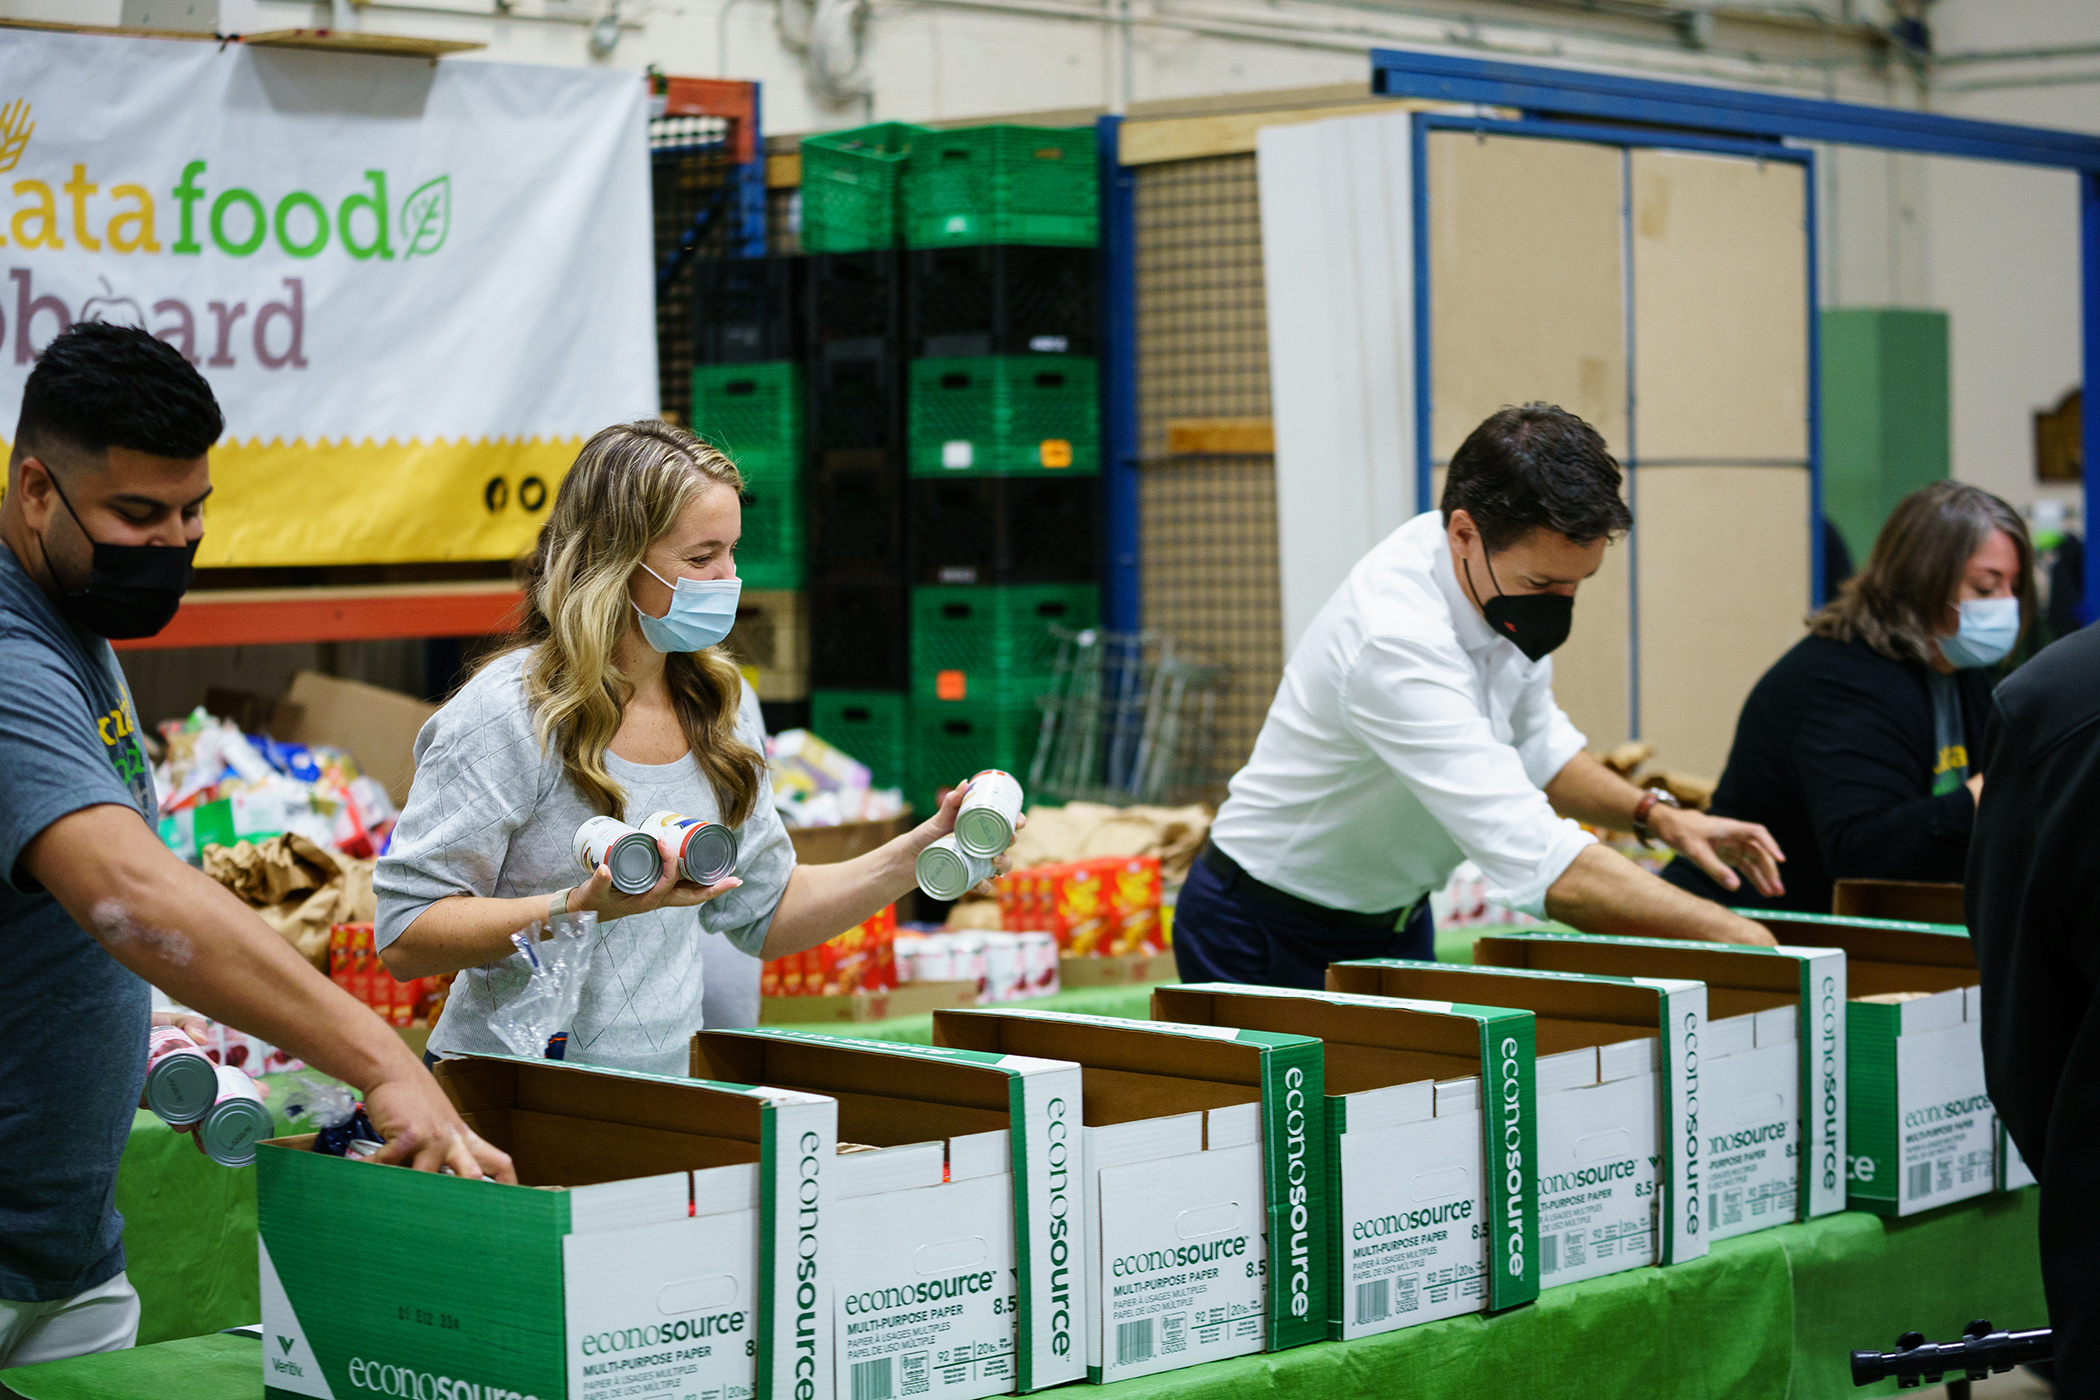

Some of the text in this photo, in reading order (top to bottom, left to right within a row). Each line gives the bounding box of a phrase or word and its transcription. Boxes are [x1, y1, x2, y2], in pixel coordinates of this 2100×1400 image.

[1822, 976, 1836, 1190] econosource
[1684, 1012, 1699, 1236] econosource
[1501, 1038, 1524, 1276] econosource
[1285, 1067, 1309, 1316] econosource
[1587, 1188, 1612, 1201] PAPER
[1047, 1097, 1070, 1357] econosource
[1353, 1200, 1472, 1240] econosource
[1113, 1236, 1245, 1277] econosource
[1353, 1230, 1448, 1259] MULTI-PURPOSE PAPER
[795, 1131, 820, 1400] econosource
[1246, 1259, 1266, 1278] 8.5
[845, 1271, 993, 1315] econosource
[1113, 1268, 1219, 1297] MULTI-PURPOSE PAPER
[1113, 1297, 1137, 1310] PAPIER
[1144, 1290, 1171, 1303] USAGES
[1172, 1284, 1208, 1299] MULTIPLES
[847, 1304, 963, 1335] MULTI-PURPOSE PAPER
[994, 1295, 1017, 1315] 8.5
[1113, 1308, 1135, 1320] PAPEL
[1136, 1306, 1146, 1316] DE
[1147, 1303, 1161, 1313] USO
[1195, 1311, 1206, 1324] 92
[582, 1311, 745, 1356] econosource
[847, 1337, 874, 1348] PAPIER
[881, 1328, 911, 1342] USAGES
[912, 1321, 951, 1336] MULTIPLES
[583, 1346, 712, 1377] MULTI-PURPOSE PAPER
[847, 1347, 870, 1360] PAPEL
[871, 1345, 883, 1355] DE
[884, 1342, 899, 1352] USO
[937, 1350, 950, 1363] 92
[583, 1378, 613, 1391] PAPIER
[621, 1371, 655, 1384] USAGES
[655, 1364, 698, 1379] MULTIPLES
[610, 1387, 622, 1398] DE
[623, 1384, 642, 1396] USO
